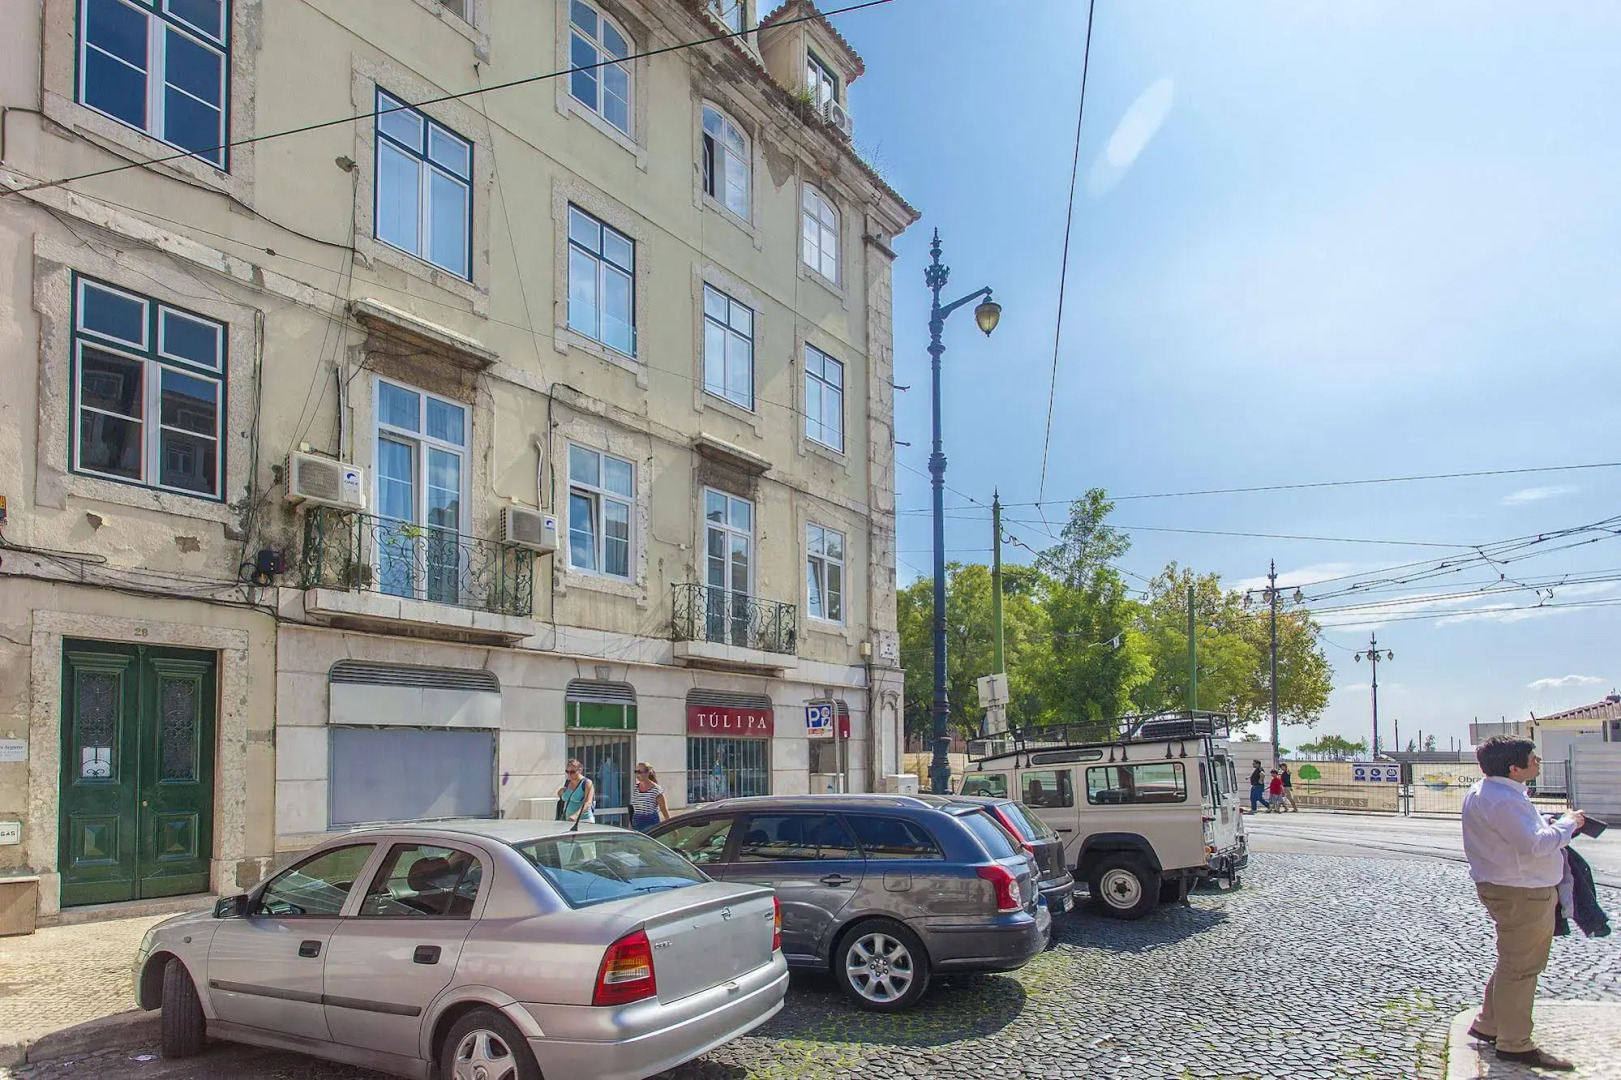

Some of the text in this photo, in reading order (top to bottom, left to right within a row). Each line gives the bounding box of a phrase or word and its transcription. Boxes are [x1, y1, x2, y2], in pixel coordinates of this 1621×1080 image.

[134, 628, 149, 637] 28
[697, 712, 767, 729] TÚLIPA
[1296, 796, 1365, 807] VIBEIRAS
